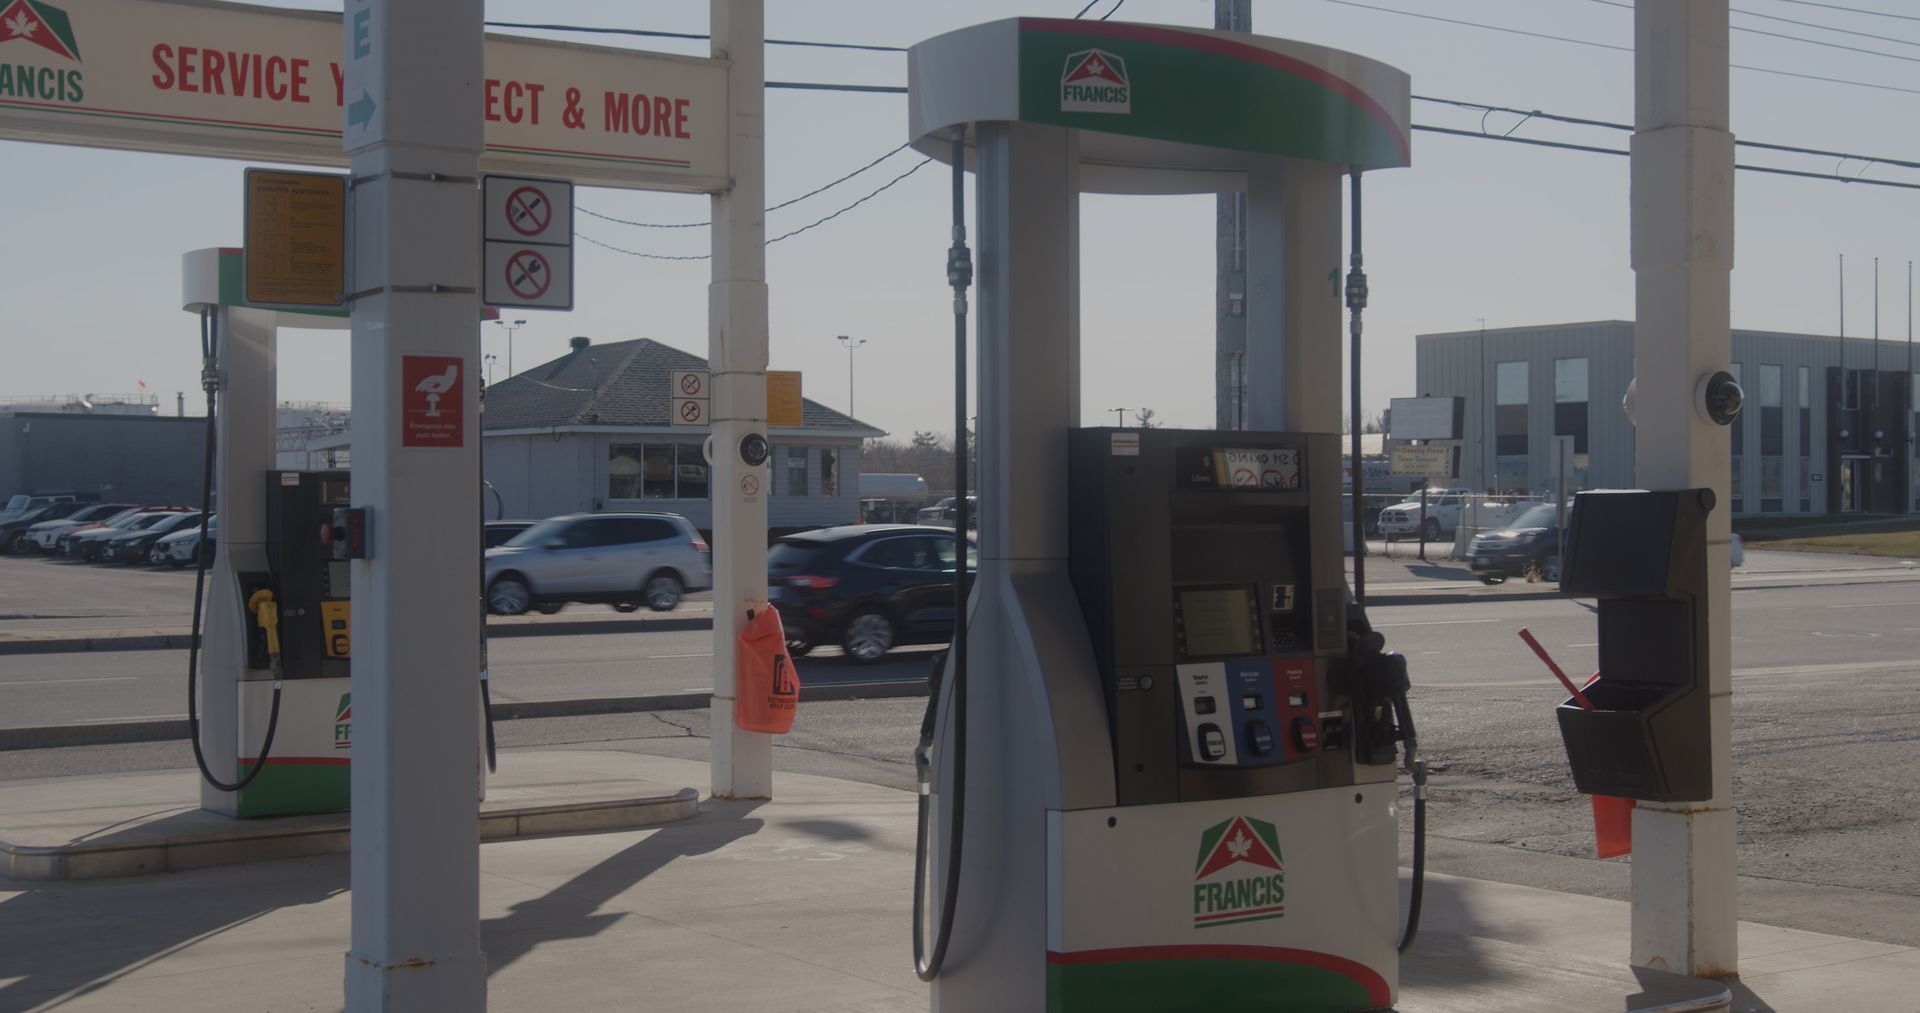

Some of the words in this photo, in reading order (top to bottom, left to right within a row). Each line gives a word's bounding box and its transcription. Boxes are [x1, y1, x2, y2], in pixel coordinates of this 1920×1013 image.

[353, 7, 371, 60] E
[0, 63, 84, 103] ANCIS
[152, 43, 311, 103] SERVICE
[485, 79, 544, 125] ECT
[562, 87, 585, 130] &
[604, 91, 691, 139] MORE
[1063, 85, 1127, 103] FRANCIS
[1327, 267, 1339, 298] 1
[1194, 874, 1284, 913] FRANCIS
